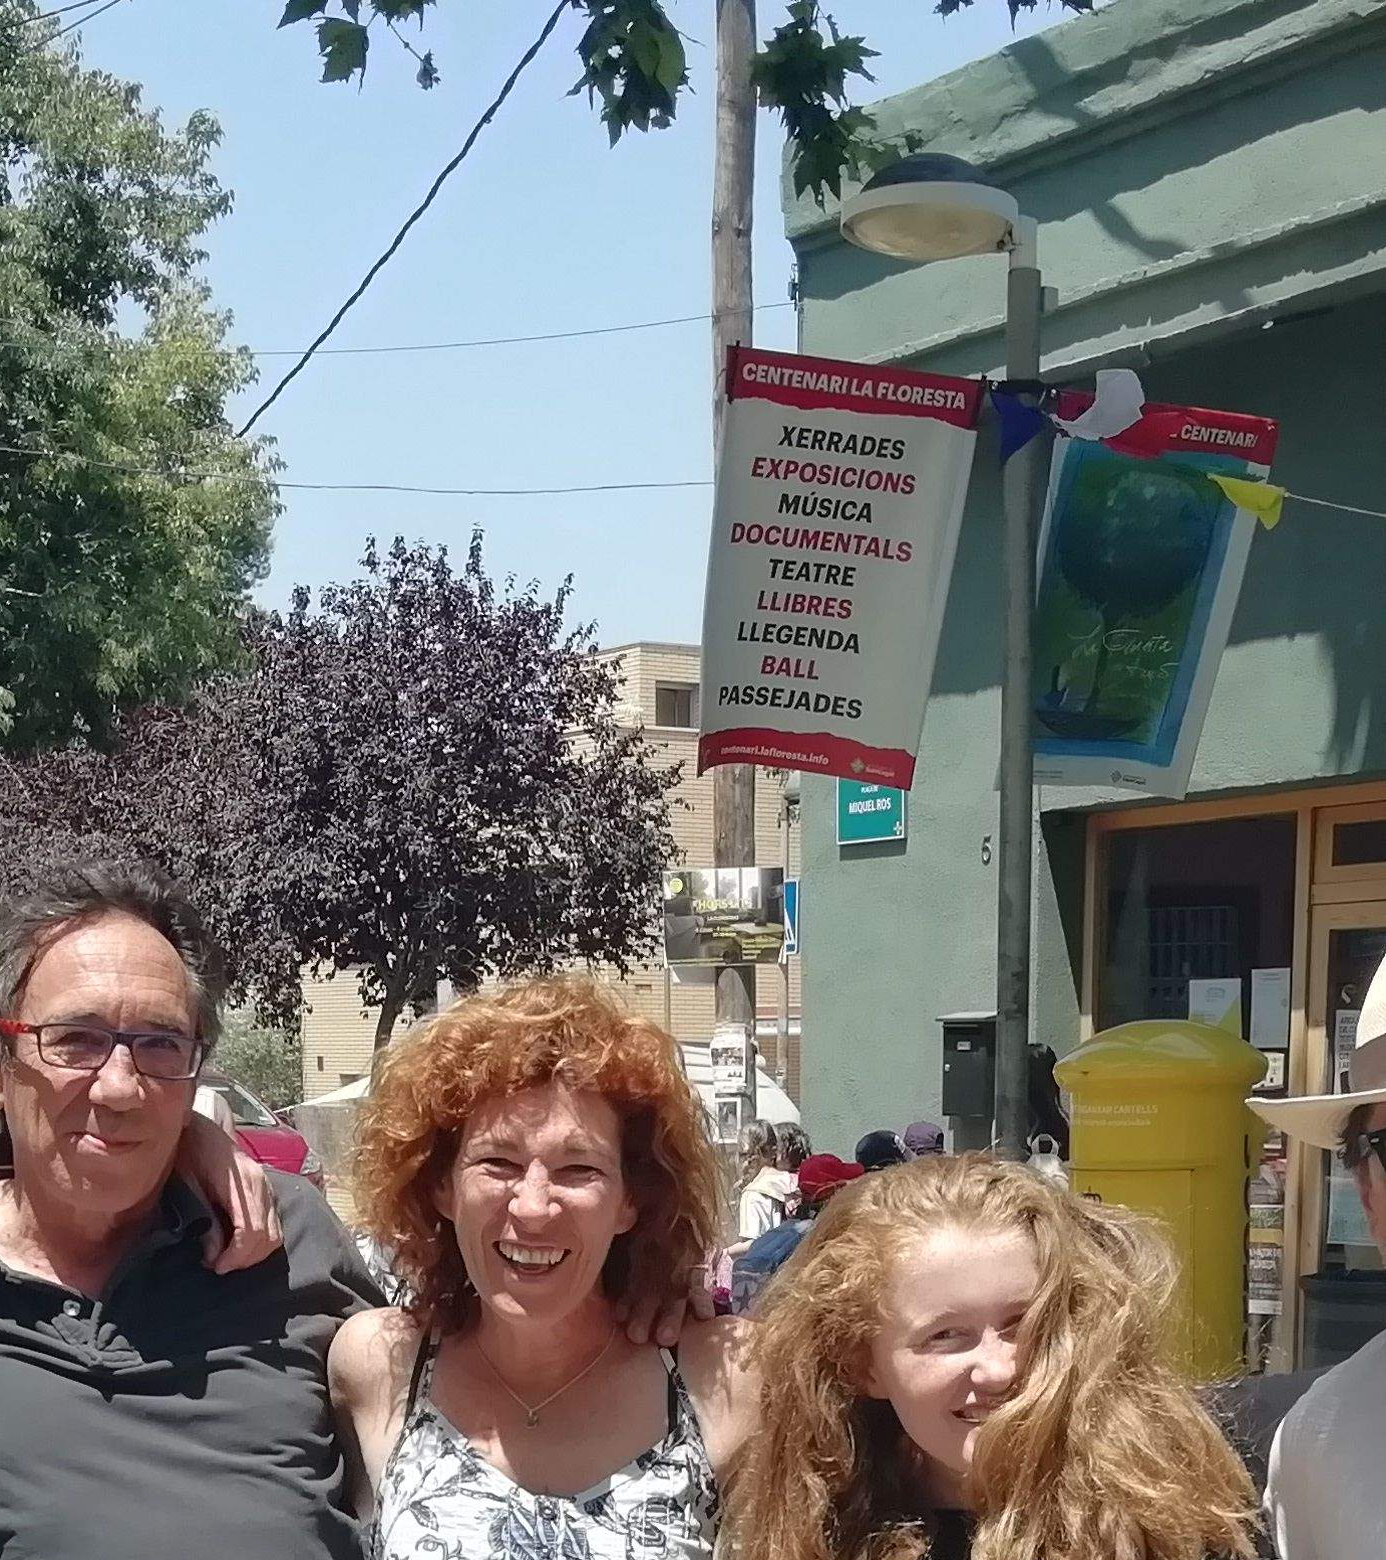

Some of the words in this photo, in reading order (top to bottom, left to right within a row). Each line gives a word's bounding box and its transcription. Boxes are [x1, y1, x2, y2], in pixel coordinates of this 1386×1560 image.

[742, 362, 847, 395] CENTENARI
[851, 377, 873, 398] LA
[877, 381, 966, 409] FLORESTA
[778, 425, 906, 460] XERRADES
[751, 457, 917, 495] EXPOSICIONS
[778, 491, 873, 523] MÚSICA
[730, 522, 913, 562] DOCUMENTALS
[769, 558, 857, 587] TEATRE
[756, 590, 853, 619] LLIBRES
[737, 621, 860, 654] LLEGENDA
[760, 655, 819, 680] BALL
[718, 685, 863, 719] PASSEJADES
[848, 799, 876, 815] MIQUEL
[877, 797, 891, 810] ROS
